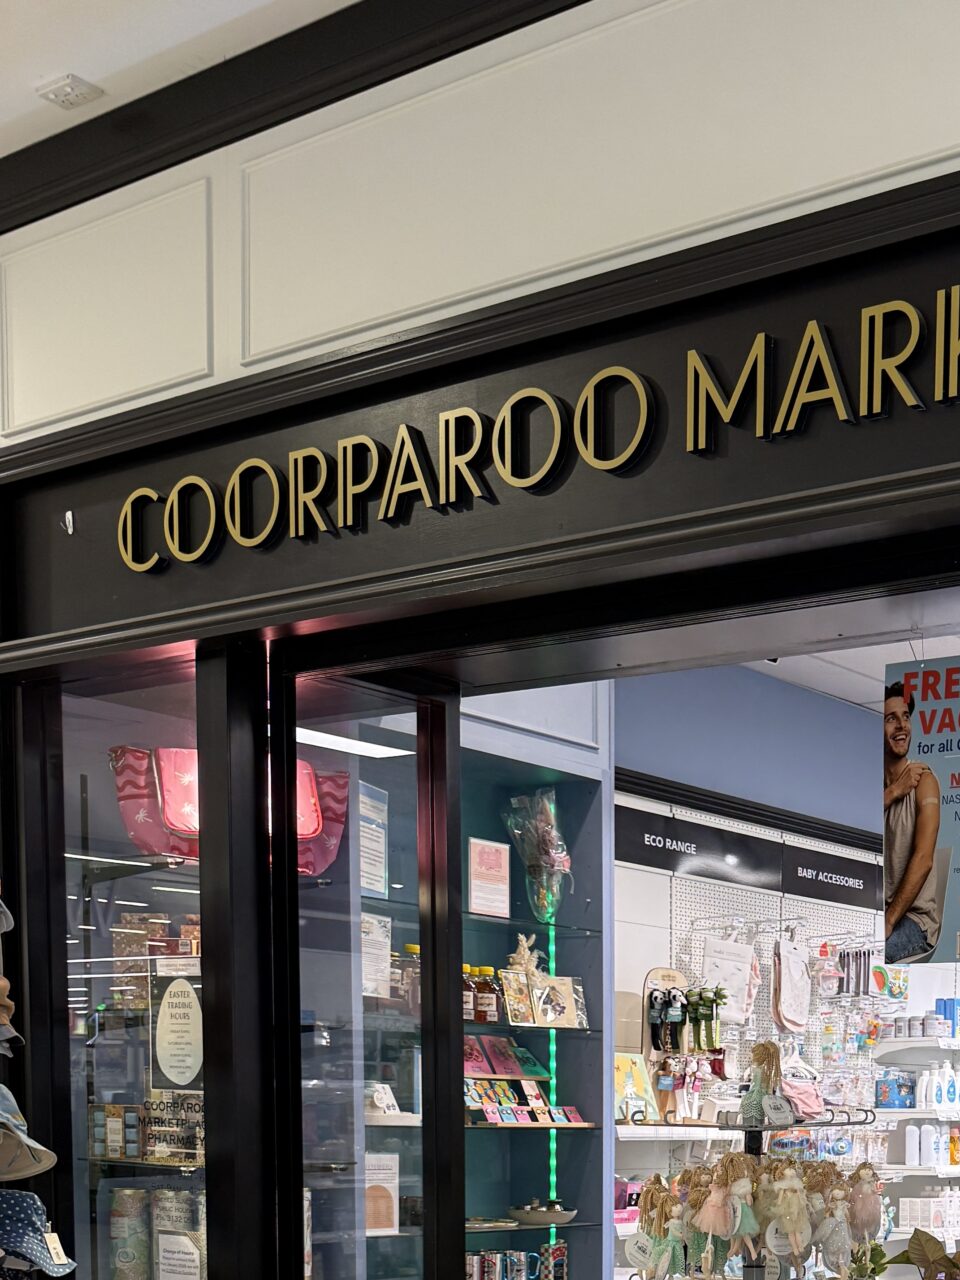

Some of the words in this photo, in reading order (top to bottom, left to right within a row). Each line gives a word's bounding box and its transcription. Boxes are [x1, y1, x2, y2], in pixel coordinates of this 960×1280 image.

[117, 365, 650, 573] COORPAROO
[917, 741, 936, 755] for
[938, 738, 953, 753] all
[644, 833, 664, 848] ECO
[665, 837, 697, 855] RANGE
[797, 867, 816, 881] BABY
[818, 871, 864, 889] ACCESSORIES
[169, 990, 190, 999] EASTER
[167, 1002, 192, 1010] TRADING
[170, 1012, 190, 1020] HOURS
